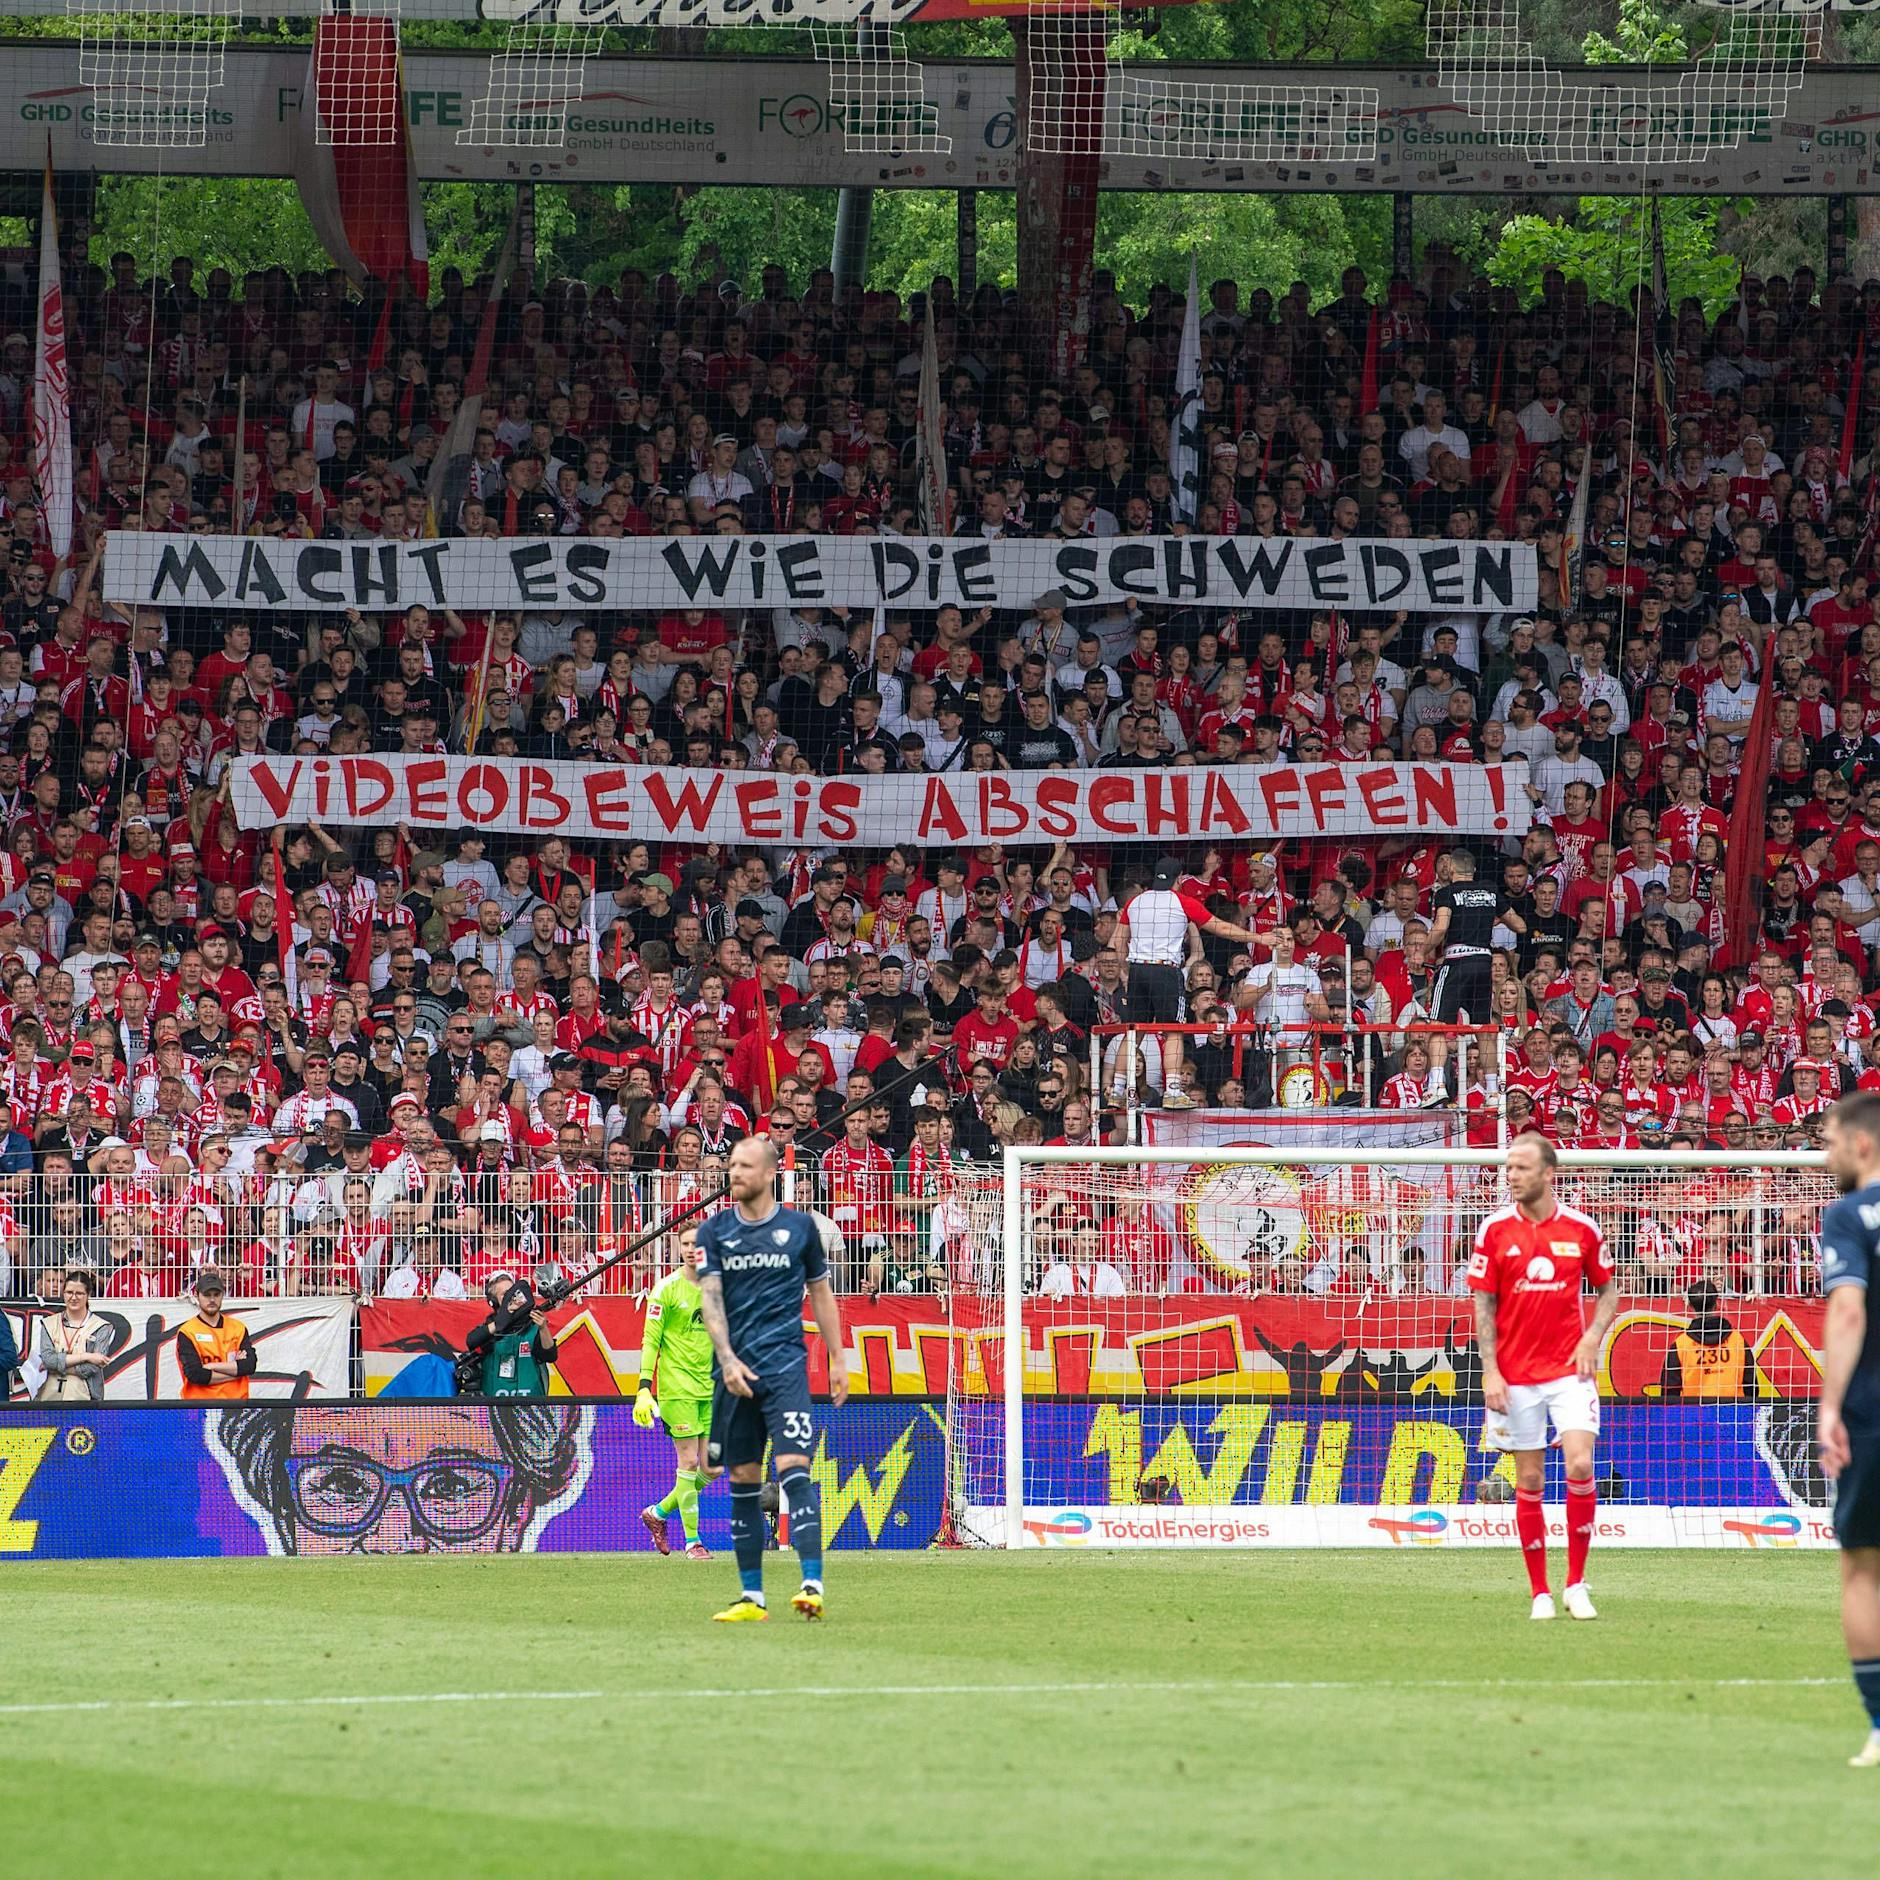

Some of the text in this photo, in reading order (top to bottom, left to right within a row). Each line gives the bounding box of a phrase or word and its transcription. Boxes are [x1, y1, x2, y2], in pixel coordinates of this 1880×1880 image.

[20, 104, 233, 124] GHD GesundHeits
[759, 94, 939, 138] FORLIFE
[1120, 99, 1300, 141] FORLIFE
[508, 115, 715, 134] GHD GesundHeits
[1590, 104, 1773, 147] FORLIFE
[567, 137, 613, 150] GmbH
[620, 138, 715, 152] Deutschland
[1346, 127, 1549, 146] GHD GesundHeits
[1816, 129, 1867, 147] GHD
[1403, 149, 1448, 162] GmbH
[150, 540, 450, 604] MACHT
[509, 541, 611, 602] ES
[1056, 538, 1514, 608] SCHWEDEN
[721, 1253, 791, 1271] VONOVIA
[1695, 1347, 1730, 1365] 230
[783, 1411, 813, 1440] 33
[1083, 1403, 1517, 1504] WILD
[1099, 1519, 1269, 1544] TotalEnergies
